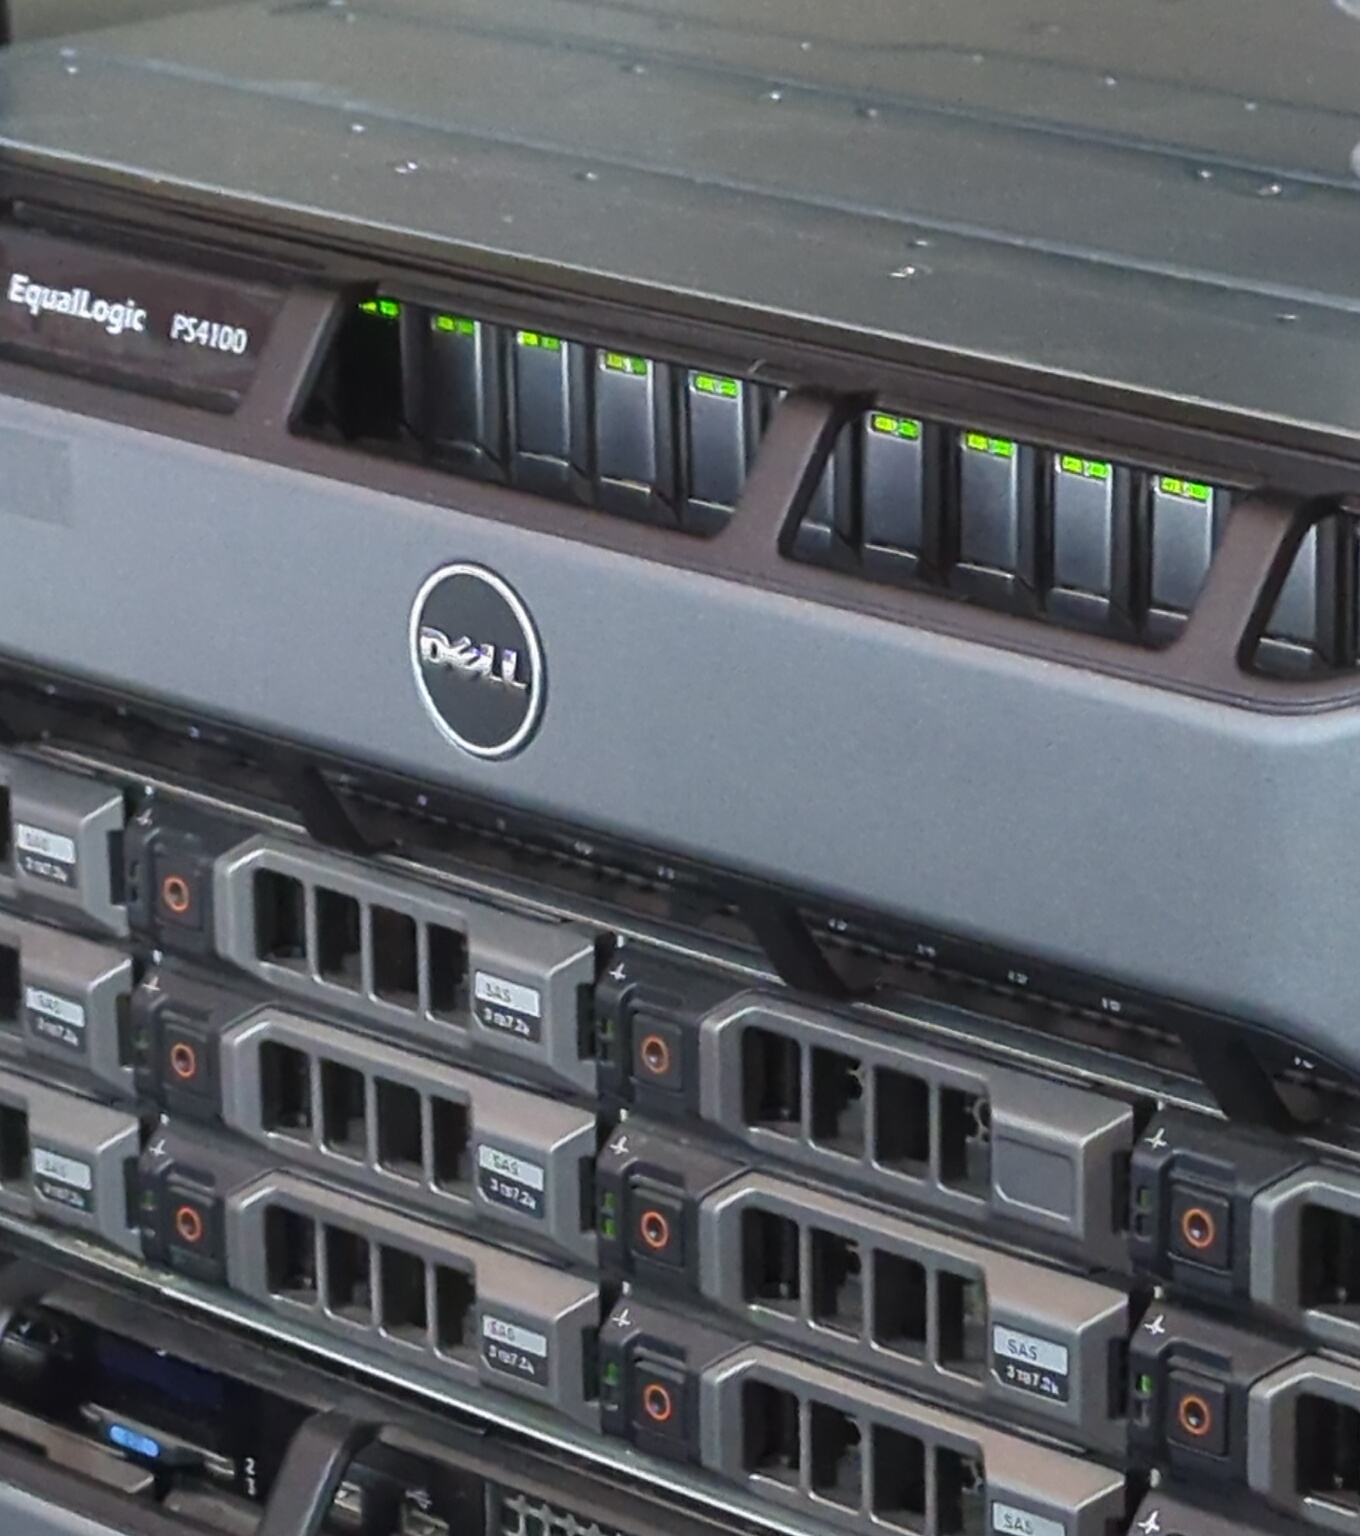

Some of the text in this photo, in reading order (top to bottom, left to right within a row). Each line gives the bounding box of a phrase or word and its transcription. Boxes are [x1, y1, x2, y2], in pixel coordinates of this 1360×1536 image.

[7, 273, 249, 354] EqualLogic PS4100
[420, 626, 528, 690] DELL
[1007, 1338, 1037, 1361] SAS
[1003, 1513, 1033, 1535] SAS
